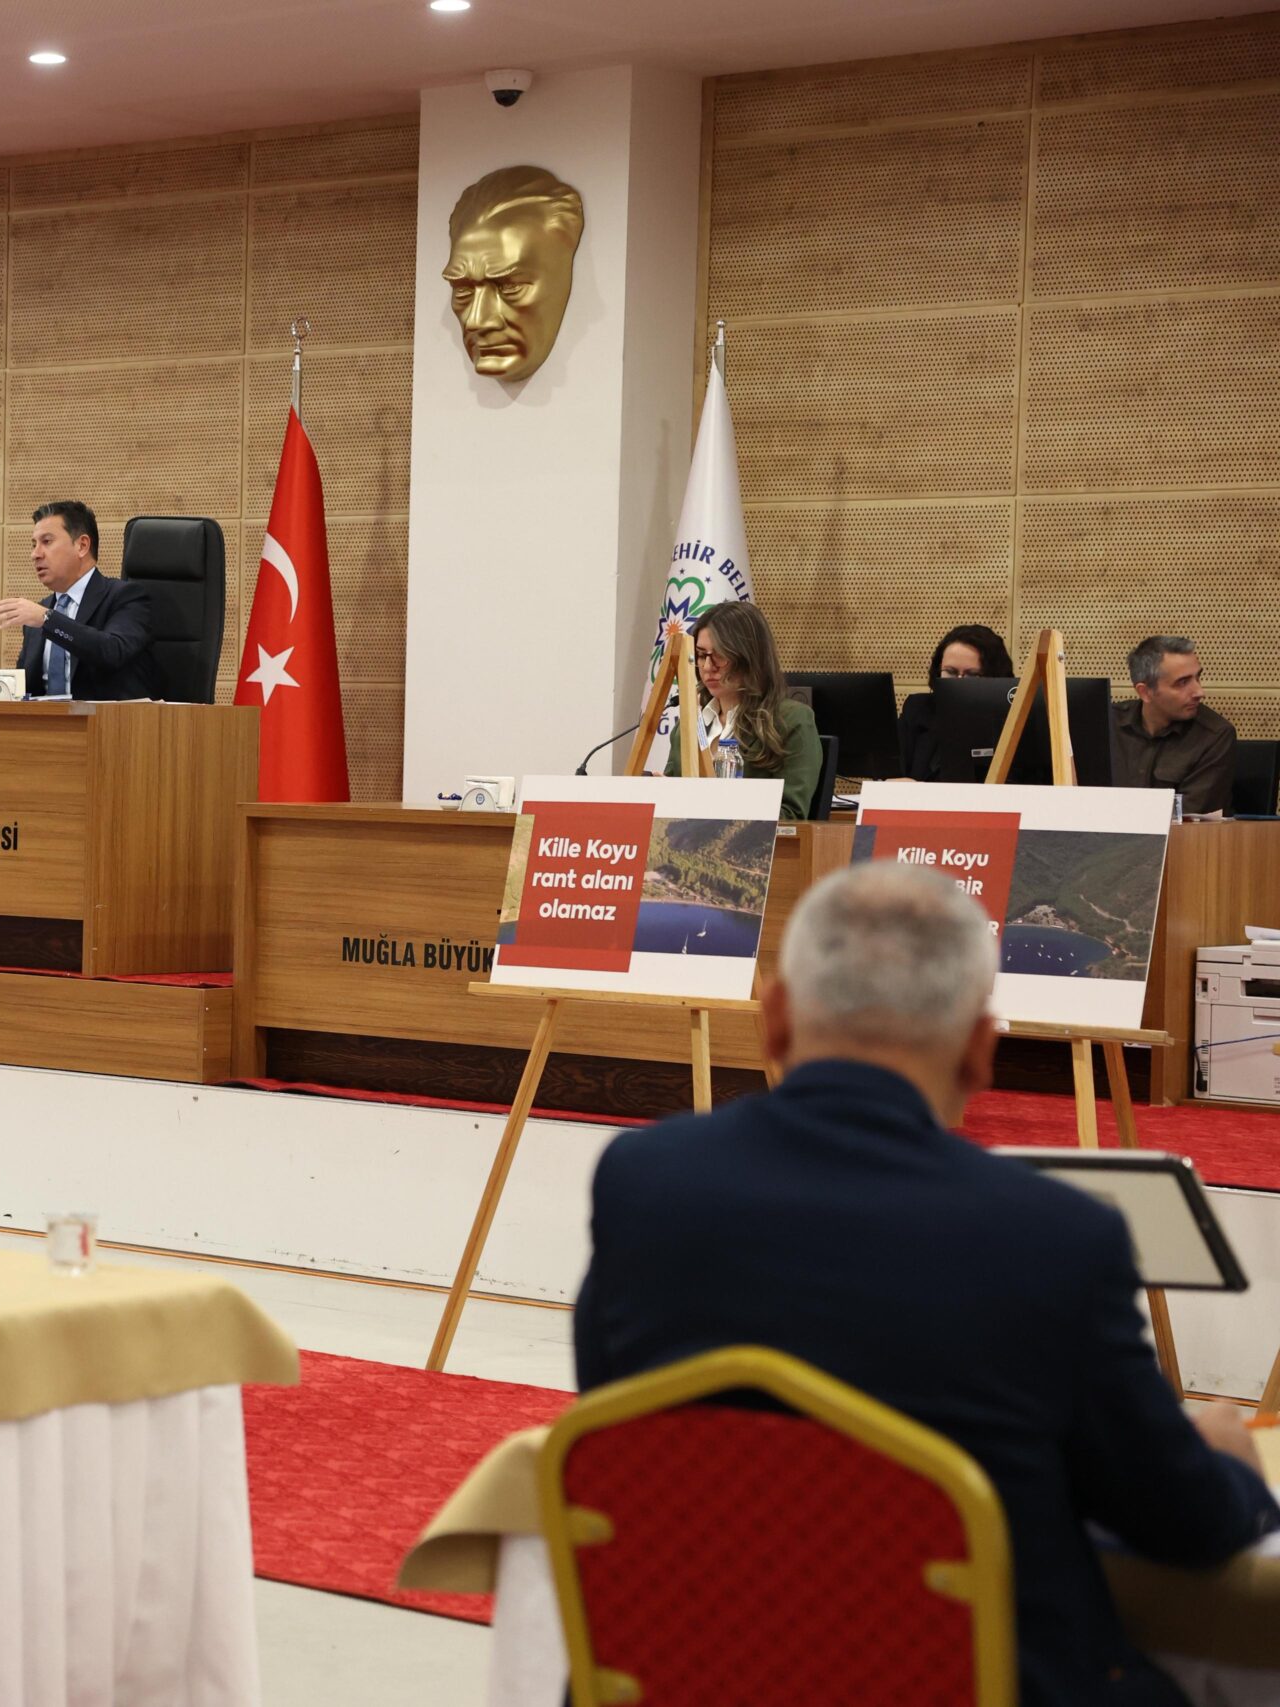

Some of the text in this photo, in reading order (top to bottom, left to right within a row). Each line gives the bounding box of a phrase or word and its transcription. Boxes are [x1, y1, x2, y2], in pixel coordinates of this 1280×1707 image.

[672, 539, 751, 602] EHİR BELE
[538, 837, 638, 865] Kille Koyu
[896, 847, 989, 871] Kille Koyu
[531, 870, 634, 891] rant alanı
[538, 898, 617, 921] olamaz
[341, 933, 496, 974] MUĞLA BÜYÜK
